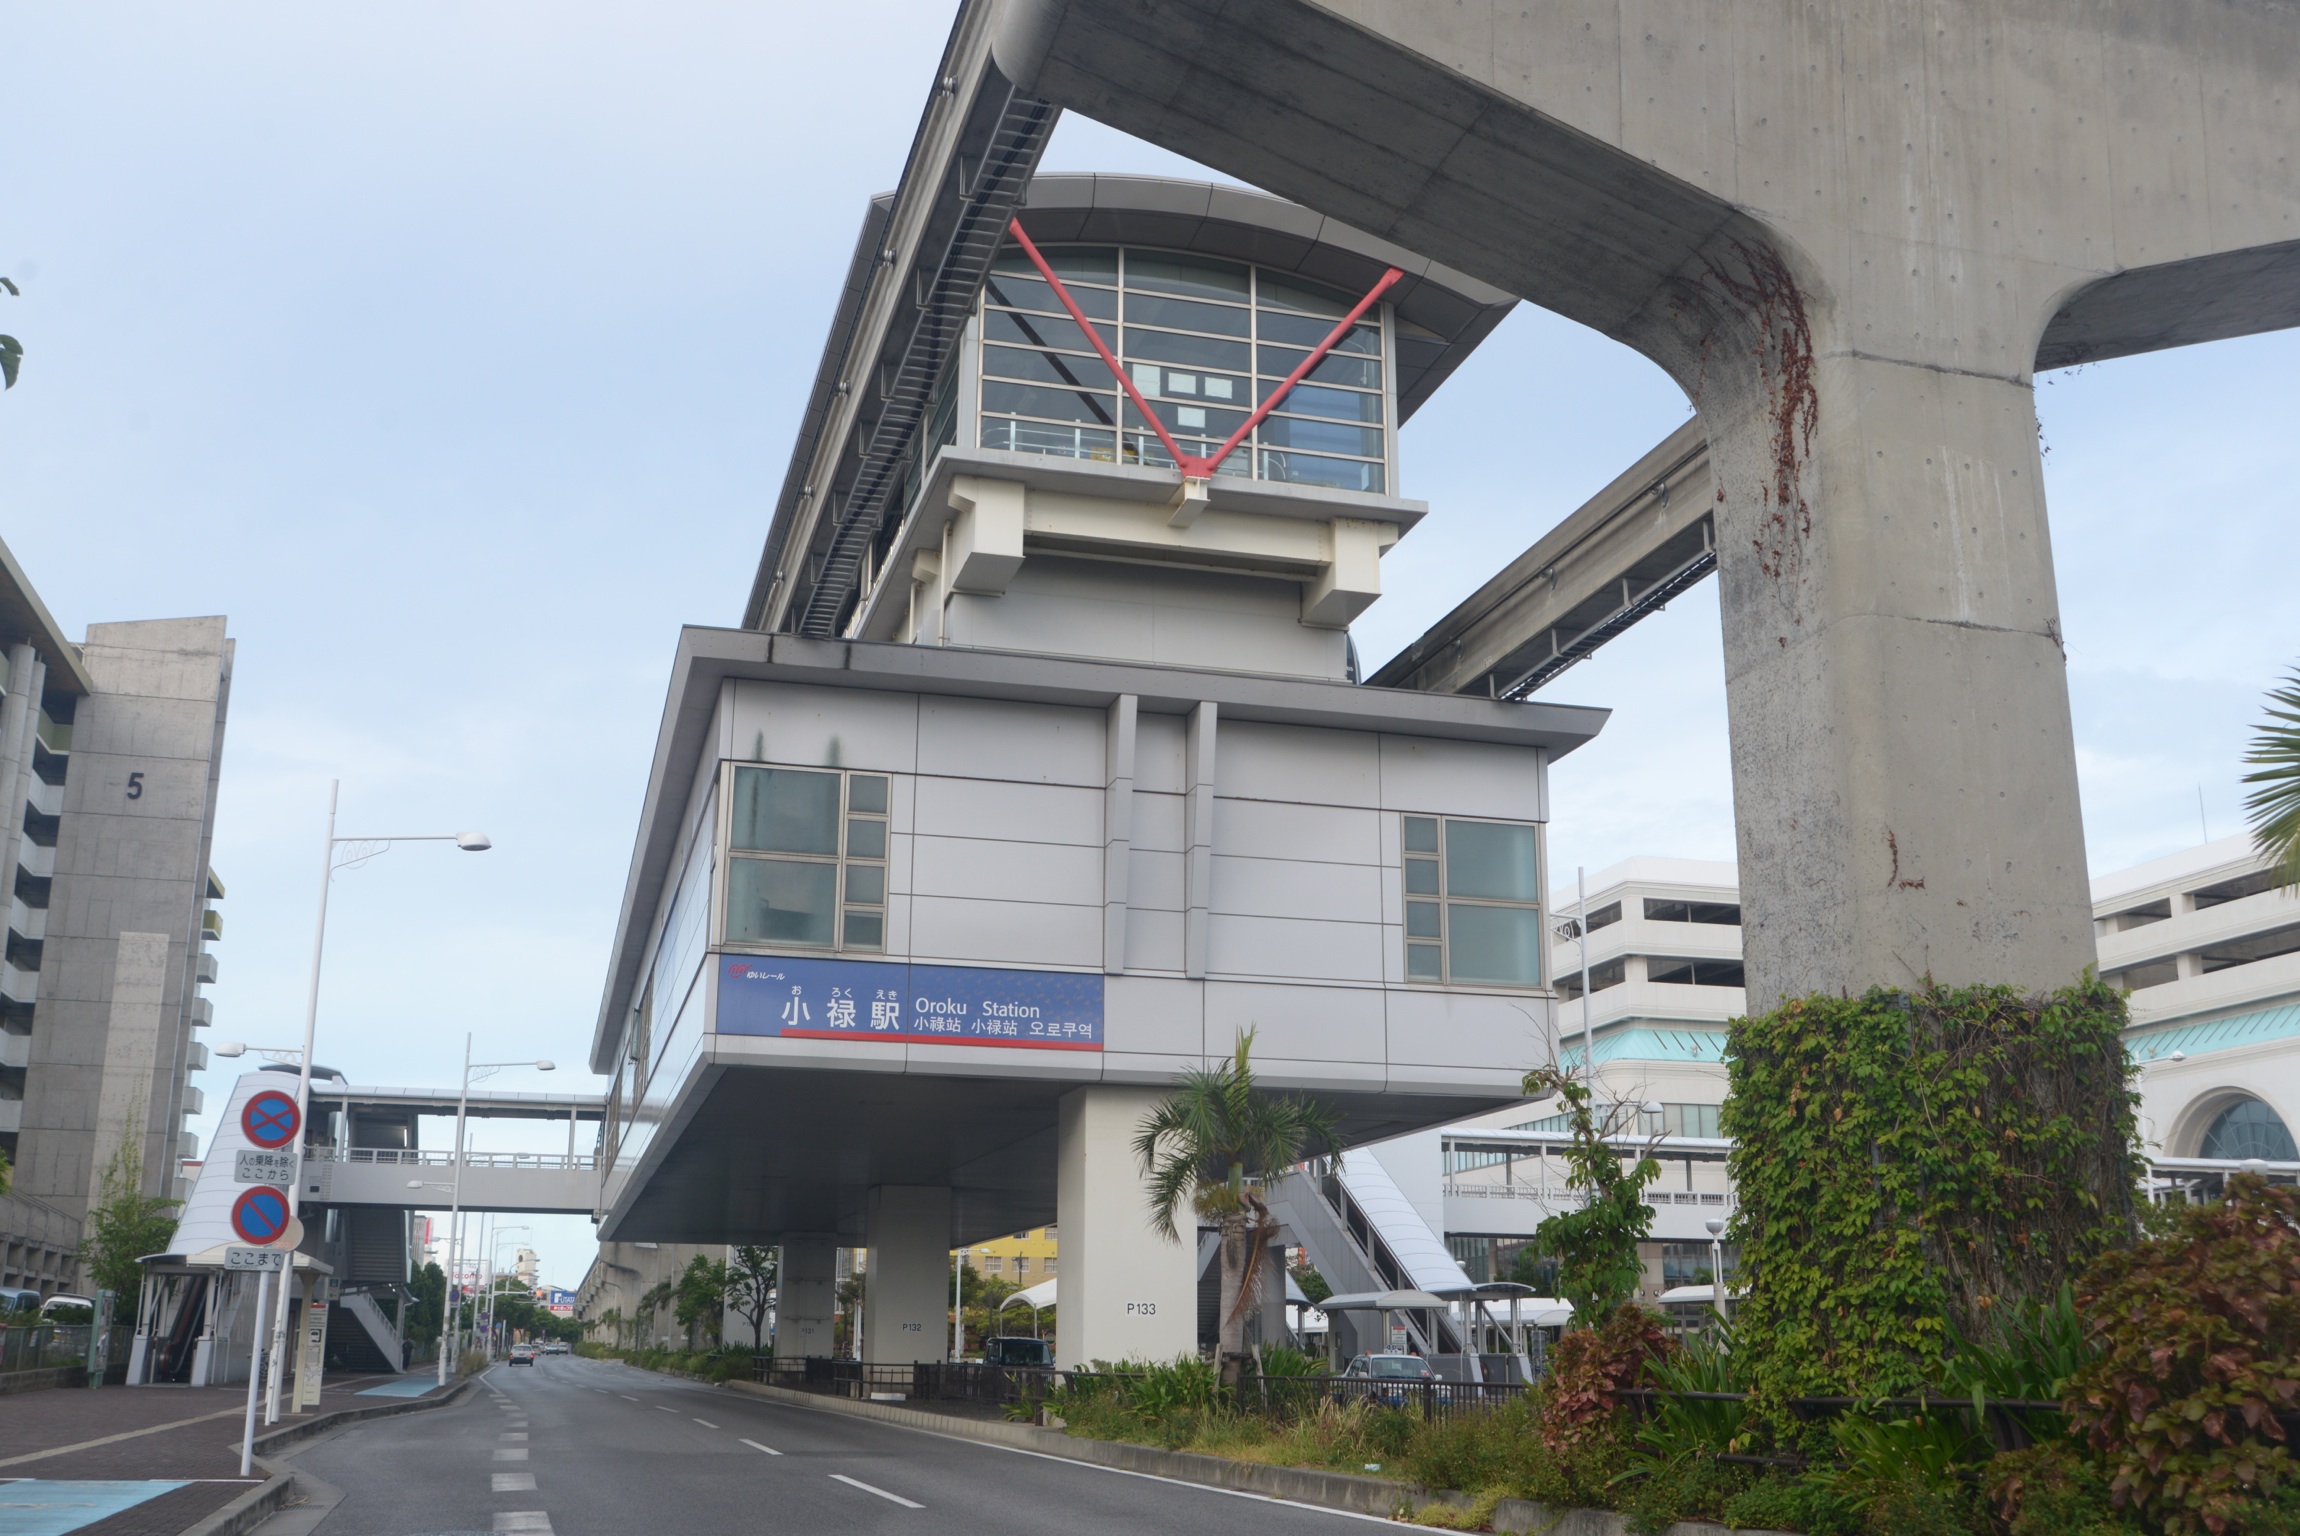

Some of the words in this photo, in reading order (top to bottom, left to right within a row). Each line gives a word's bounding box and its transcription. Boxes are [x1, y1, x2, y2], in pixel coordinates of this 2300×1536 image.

[127, 772, 145, 800] 5
[746, 970, 785, 981] ゆいレール
[915, 997, 967, 1016] Oroku
[982, 1000, 1040, 1018] Station
[971, 1018, 1018, 1036] 小禄站
[1029, 1021, 1093, 1040] 오로쿠역
[240, 1154, 295, 1169] 人の乗降を除く
[242, 1167, 289, 1181] ここから
[230, 1252, 281, 1266] ここまで
